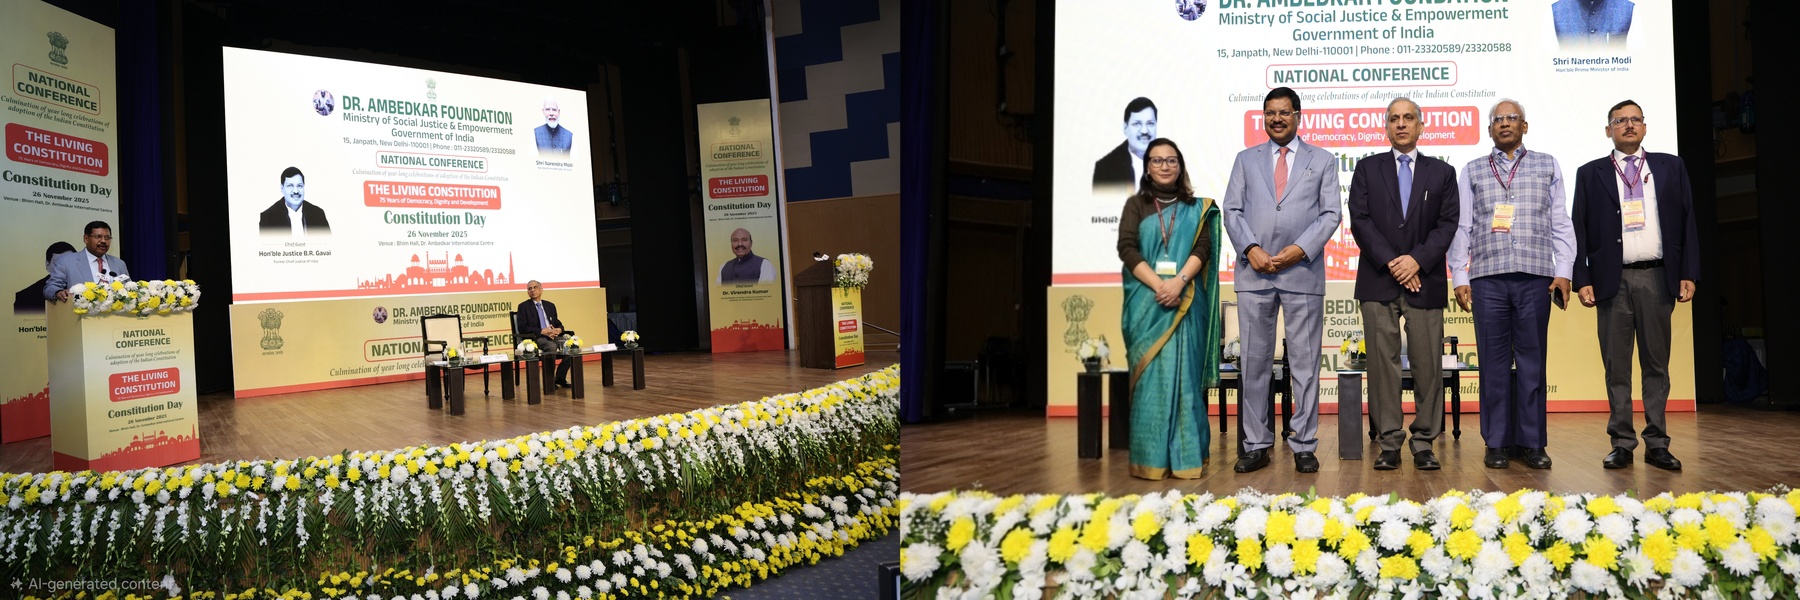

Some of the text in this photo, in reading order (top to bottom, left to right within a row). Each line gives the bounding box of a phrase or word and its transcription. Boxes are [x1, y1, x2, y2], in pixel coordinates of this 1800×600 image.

[1219, 6, 1509, 27] Ministry of Social Justice & Empowerment
[1292, 25, 1435, 41] Government of India
[1217, 48, 1229, 58] 15,
[1231, 48, 1271, 58] Janpath,
[1272, 47, 1293, 56] New
[1295, 46, 1353, 56] Delhi-110001
[1360, 45, 1390, 54] Phone
[1397, 43, 1512, 54] 011-23320589/23320588
[1552, 56, 1632, 66] Shri Narendra Modi
[1274, 67, 1450, 83] NATIONAL CONFERENCE
[28, 71, 90, 98] NATIONAL
[17, 82, 98, 112] CONFERENCE
[1228, 92, 1266, 102] Culminati
[1300, 92, 1316, 103] long
[1316, 90, 1360, 101] celebrations
[1361, 90, 1370, 102] of
[1370, 90, 1402, 102] adoption
[1412, 90, 1424, 98] the
[1425, 88, 1449, 98] Indian
[1450, 88, 1496, 98] Constitution
[0, 95, 39, 110] Culmination
[40, 106, 47, 114] of
[47, 108, 60, 117] year
[60, 110, 72, 120] long
[72, 114, 104, 126] celebrations
[342, 95, 513, 125] DR. AMBEDKAR FOUNDATION
[8, 104, 104, 132] adoption of the Indian Constitution
[343, 112, 513, 136] Ministry of Social Justice & Empowerment
[1300, 111, 1472, 129] IVING CONUTION
[25, 130, 93, 154] THE LIVING
[391, 128, 475, 142] Government of India
[1302, 132, 1310, 142] of
[1312, 132, 1356, 142] Democracy,
[1358, 132, 1385, 142] Dignity
[352, 138, 379, 147] Janpath,
[394, 140, 430, 150] Delhi-110001
[719, 144, 755, 152] NATIONAL
[14, 142, 103, 168] CONSTITUTION
[380, 154, 484, 170] NATIONAL CONFERENCE
[713, 150, 760, 160] CONFERENCE
[2, 170, 112, 198] Constitution Day
[368, 184, 498, 199] THE LIVING CONSTITUTION
[713, 185, 765, 194] CONSTITUTION
[43, 192, 73, 202] November
[708, 201, 772, 211] Constitution Day
[384, 210, 487, 228] Constitution Day
[392, 302, 512, 318] DR. AMBEDKAR FOUNDATION
[393, 318, 418, 326] Ministry
[472, 312, 510, 321] Empowermen
[1330, 316, 1360, 326] Social
[122, 328, 166, 338] NATIONAL
[116, 338, 171, 349] CONFERENCE
[372, 341, 424, 357] NATION
[122, 371, 169, 383] THE LIVING
[330, 366, 372, 377] Culmination
[373, 364, 381, 375] of
[381, 364, 396, 376] year
[396, 362, 410, 373] long
[114, 381, 176, 395] CONSTITUTION
[108, 401, 183, 419] Constitution Day
[134, 416, 156, 424] November
